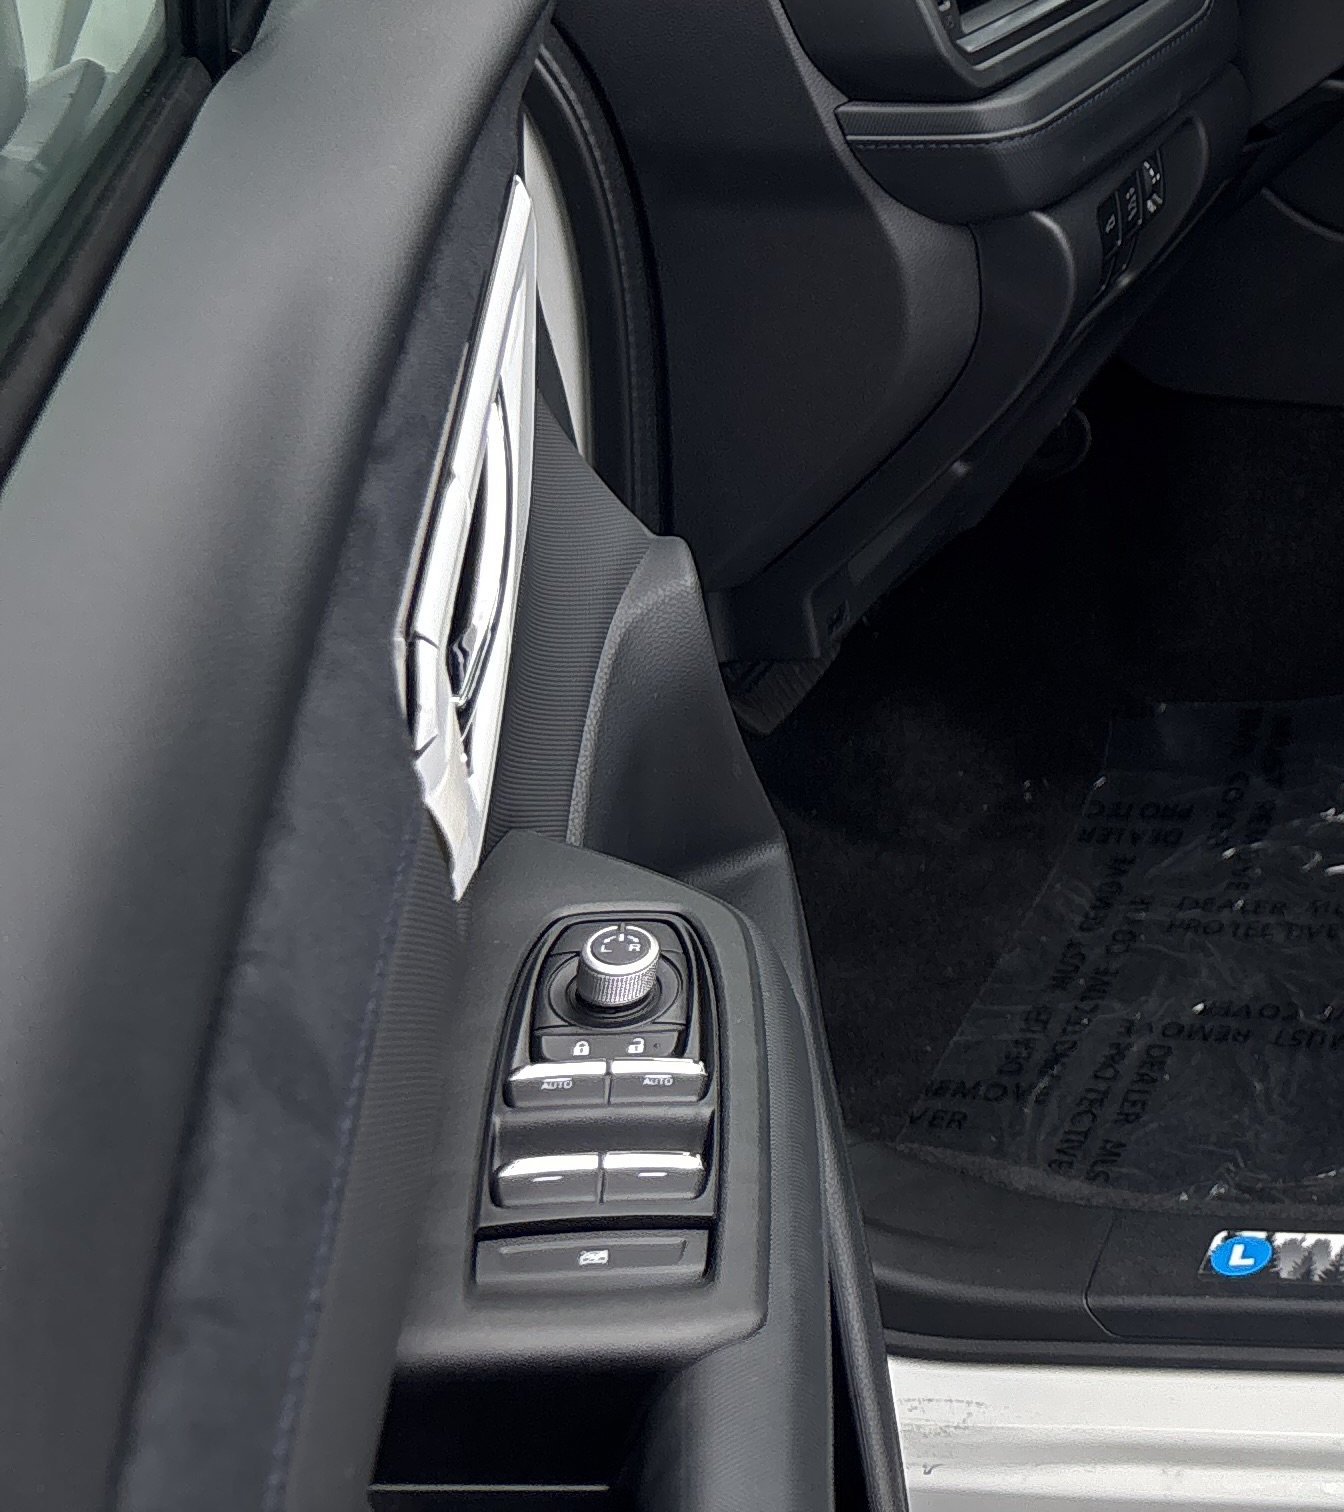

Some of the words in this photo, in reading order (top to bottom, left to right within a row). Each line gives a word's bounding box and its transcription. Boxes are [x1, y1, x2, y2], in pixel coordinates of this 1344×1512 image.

[628, 943, 642, 952] R
[540, 1079, 574, 1091] AUTO
[640, 1076, 674, 1088] AUTO
